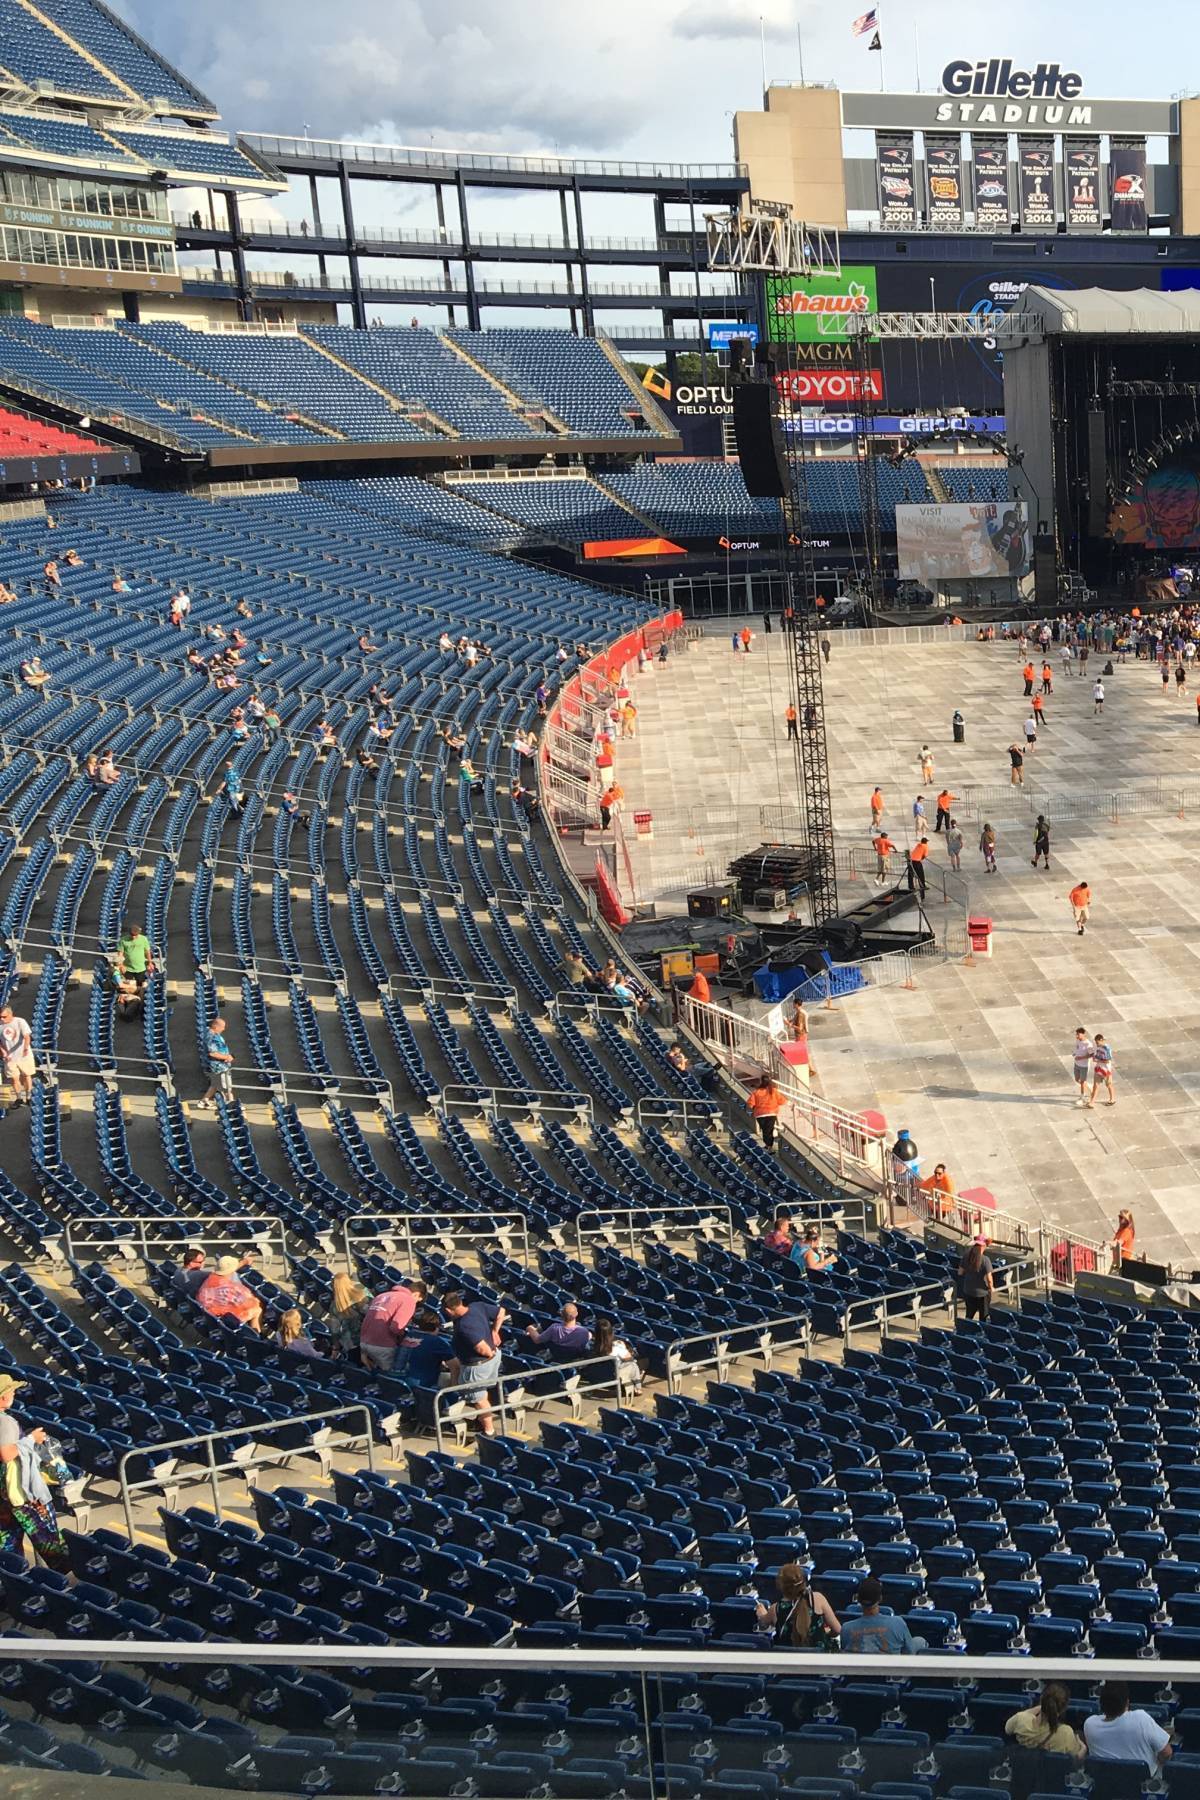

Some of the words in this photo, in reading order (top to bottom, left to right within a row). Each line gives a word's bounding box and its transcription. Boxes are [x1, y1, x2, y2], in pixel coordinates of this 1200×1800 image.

[942, 58, 1083, 99] Gillette
[936, 103, 1092, 124] STADIUM
[978, 214, 1008, 222] 2004
[1026, 215, 1052, 223] 2014
[1072, 215, 1098, 223] 2016
[797, 344, 853, 360] MGM
[677, 406, 707, 414] FIELD
[783, 419, 854, 432] GEICO
[900, 418, 968, 432] GEICO
[920, 507, 942, 515] VISIT
